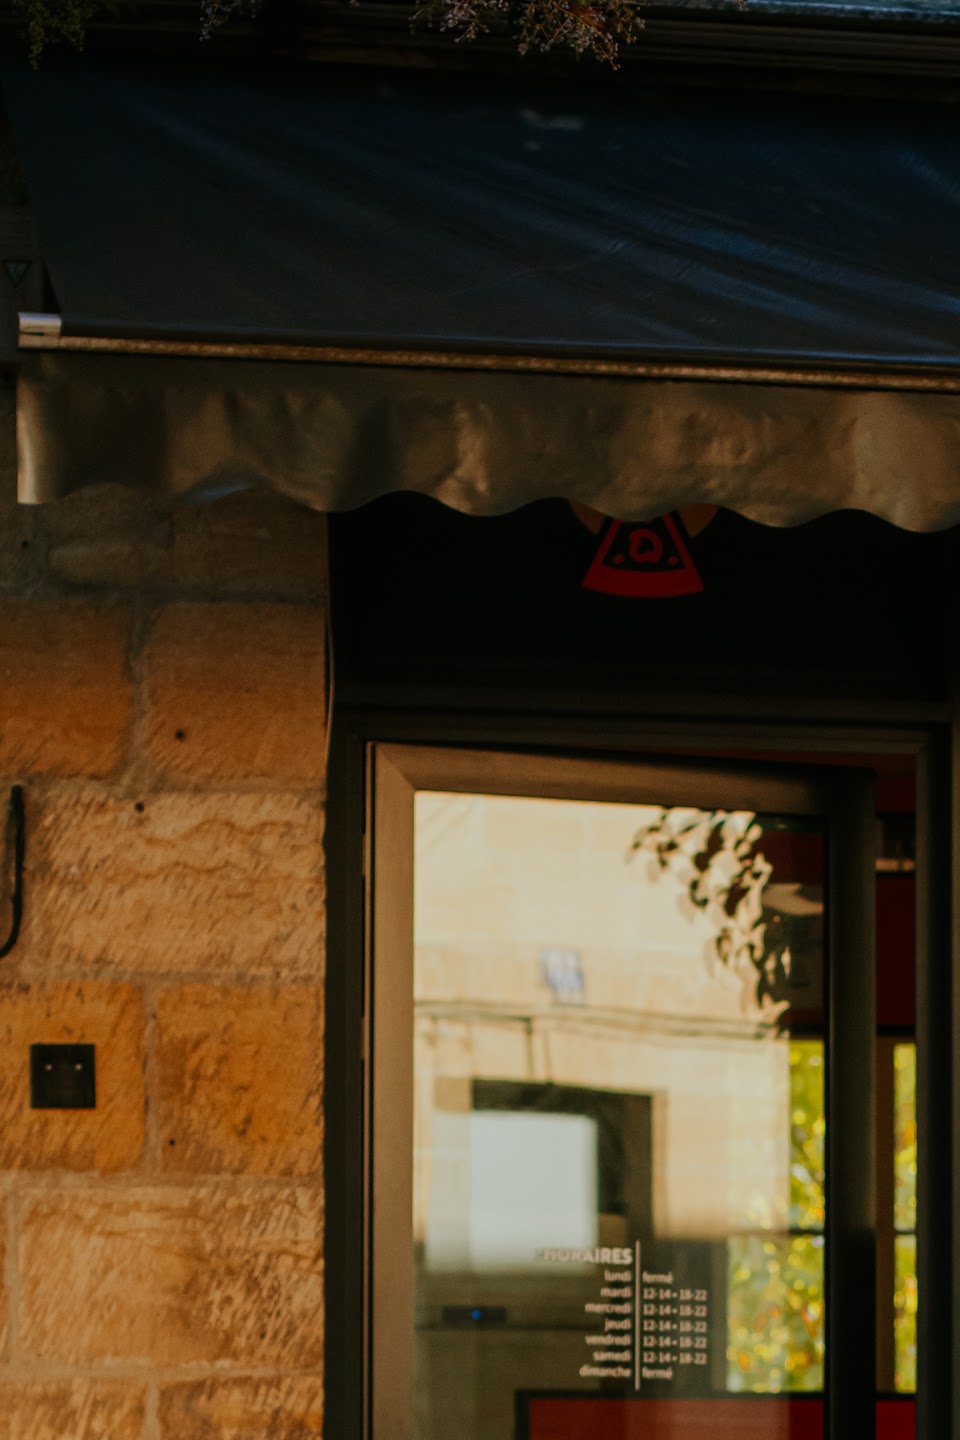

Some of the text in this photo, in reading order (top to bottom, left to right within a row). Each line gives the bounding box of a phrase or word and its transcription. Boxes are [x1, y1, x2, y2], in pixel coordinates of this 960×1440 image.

[542, 1247, 633, 1265] HORAIRES
[604, 1270, 631, 1281] lundi
[601, 1286, 631, 1297] mardi
[584, 1302, 631, 1313] mercredi
[604, 1318, 631, 1331] jeudi
[585, 1334, 631, 1345] vendredi
[593, 1350, 631, 1361] samedi
[579, 1364, 631, 1377] dimanche
